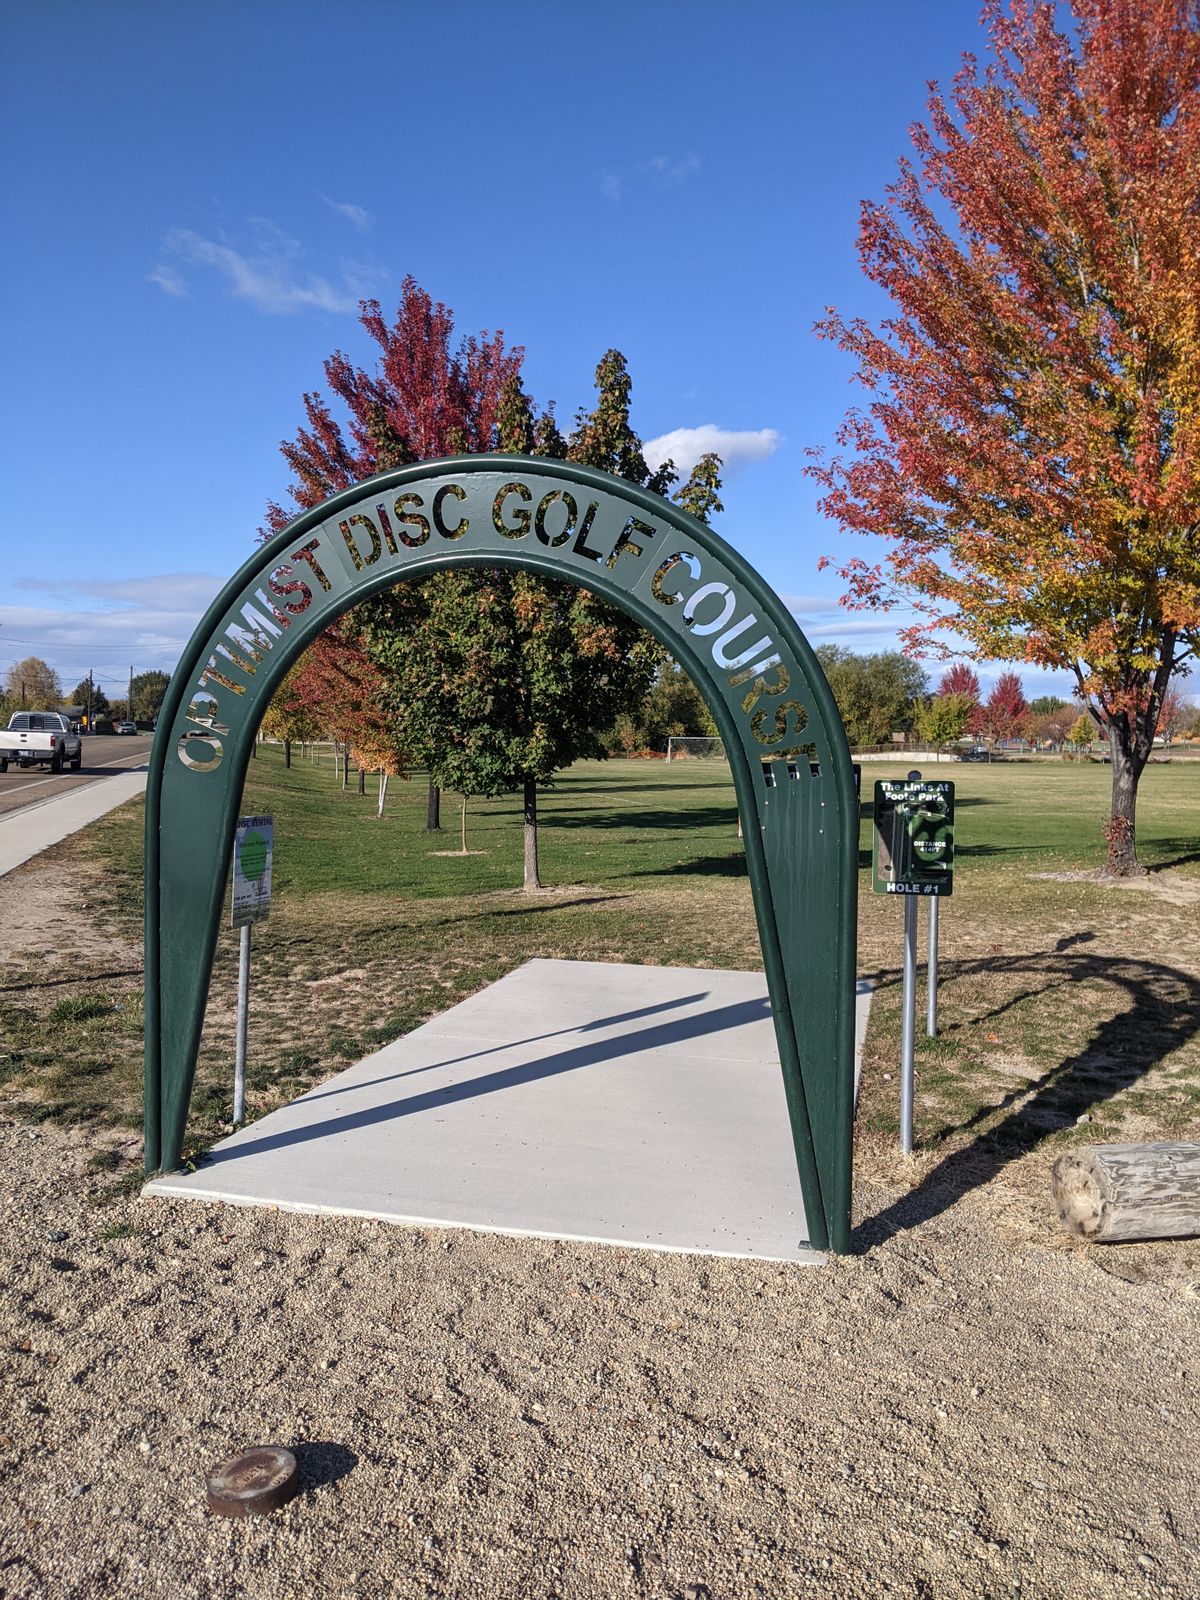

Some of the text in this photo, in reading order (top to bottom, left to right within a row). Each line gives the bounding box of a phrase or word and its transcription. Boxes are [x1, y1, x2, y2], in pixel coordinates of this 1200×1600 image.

[177, 482, 822, 788] OPTIMIST DISC GOLF COURSE
[881, 783, 949, 792] The Links At
[918, 793, 944, 801] Park
[887, 883, 939, 893] HOLE #1
